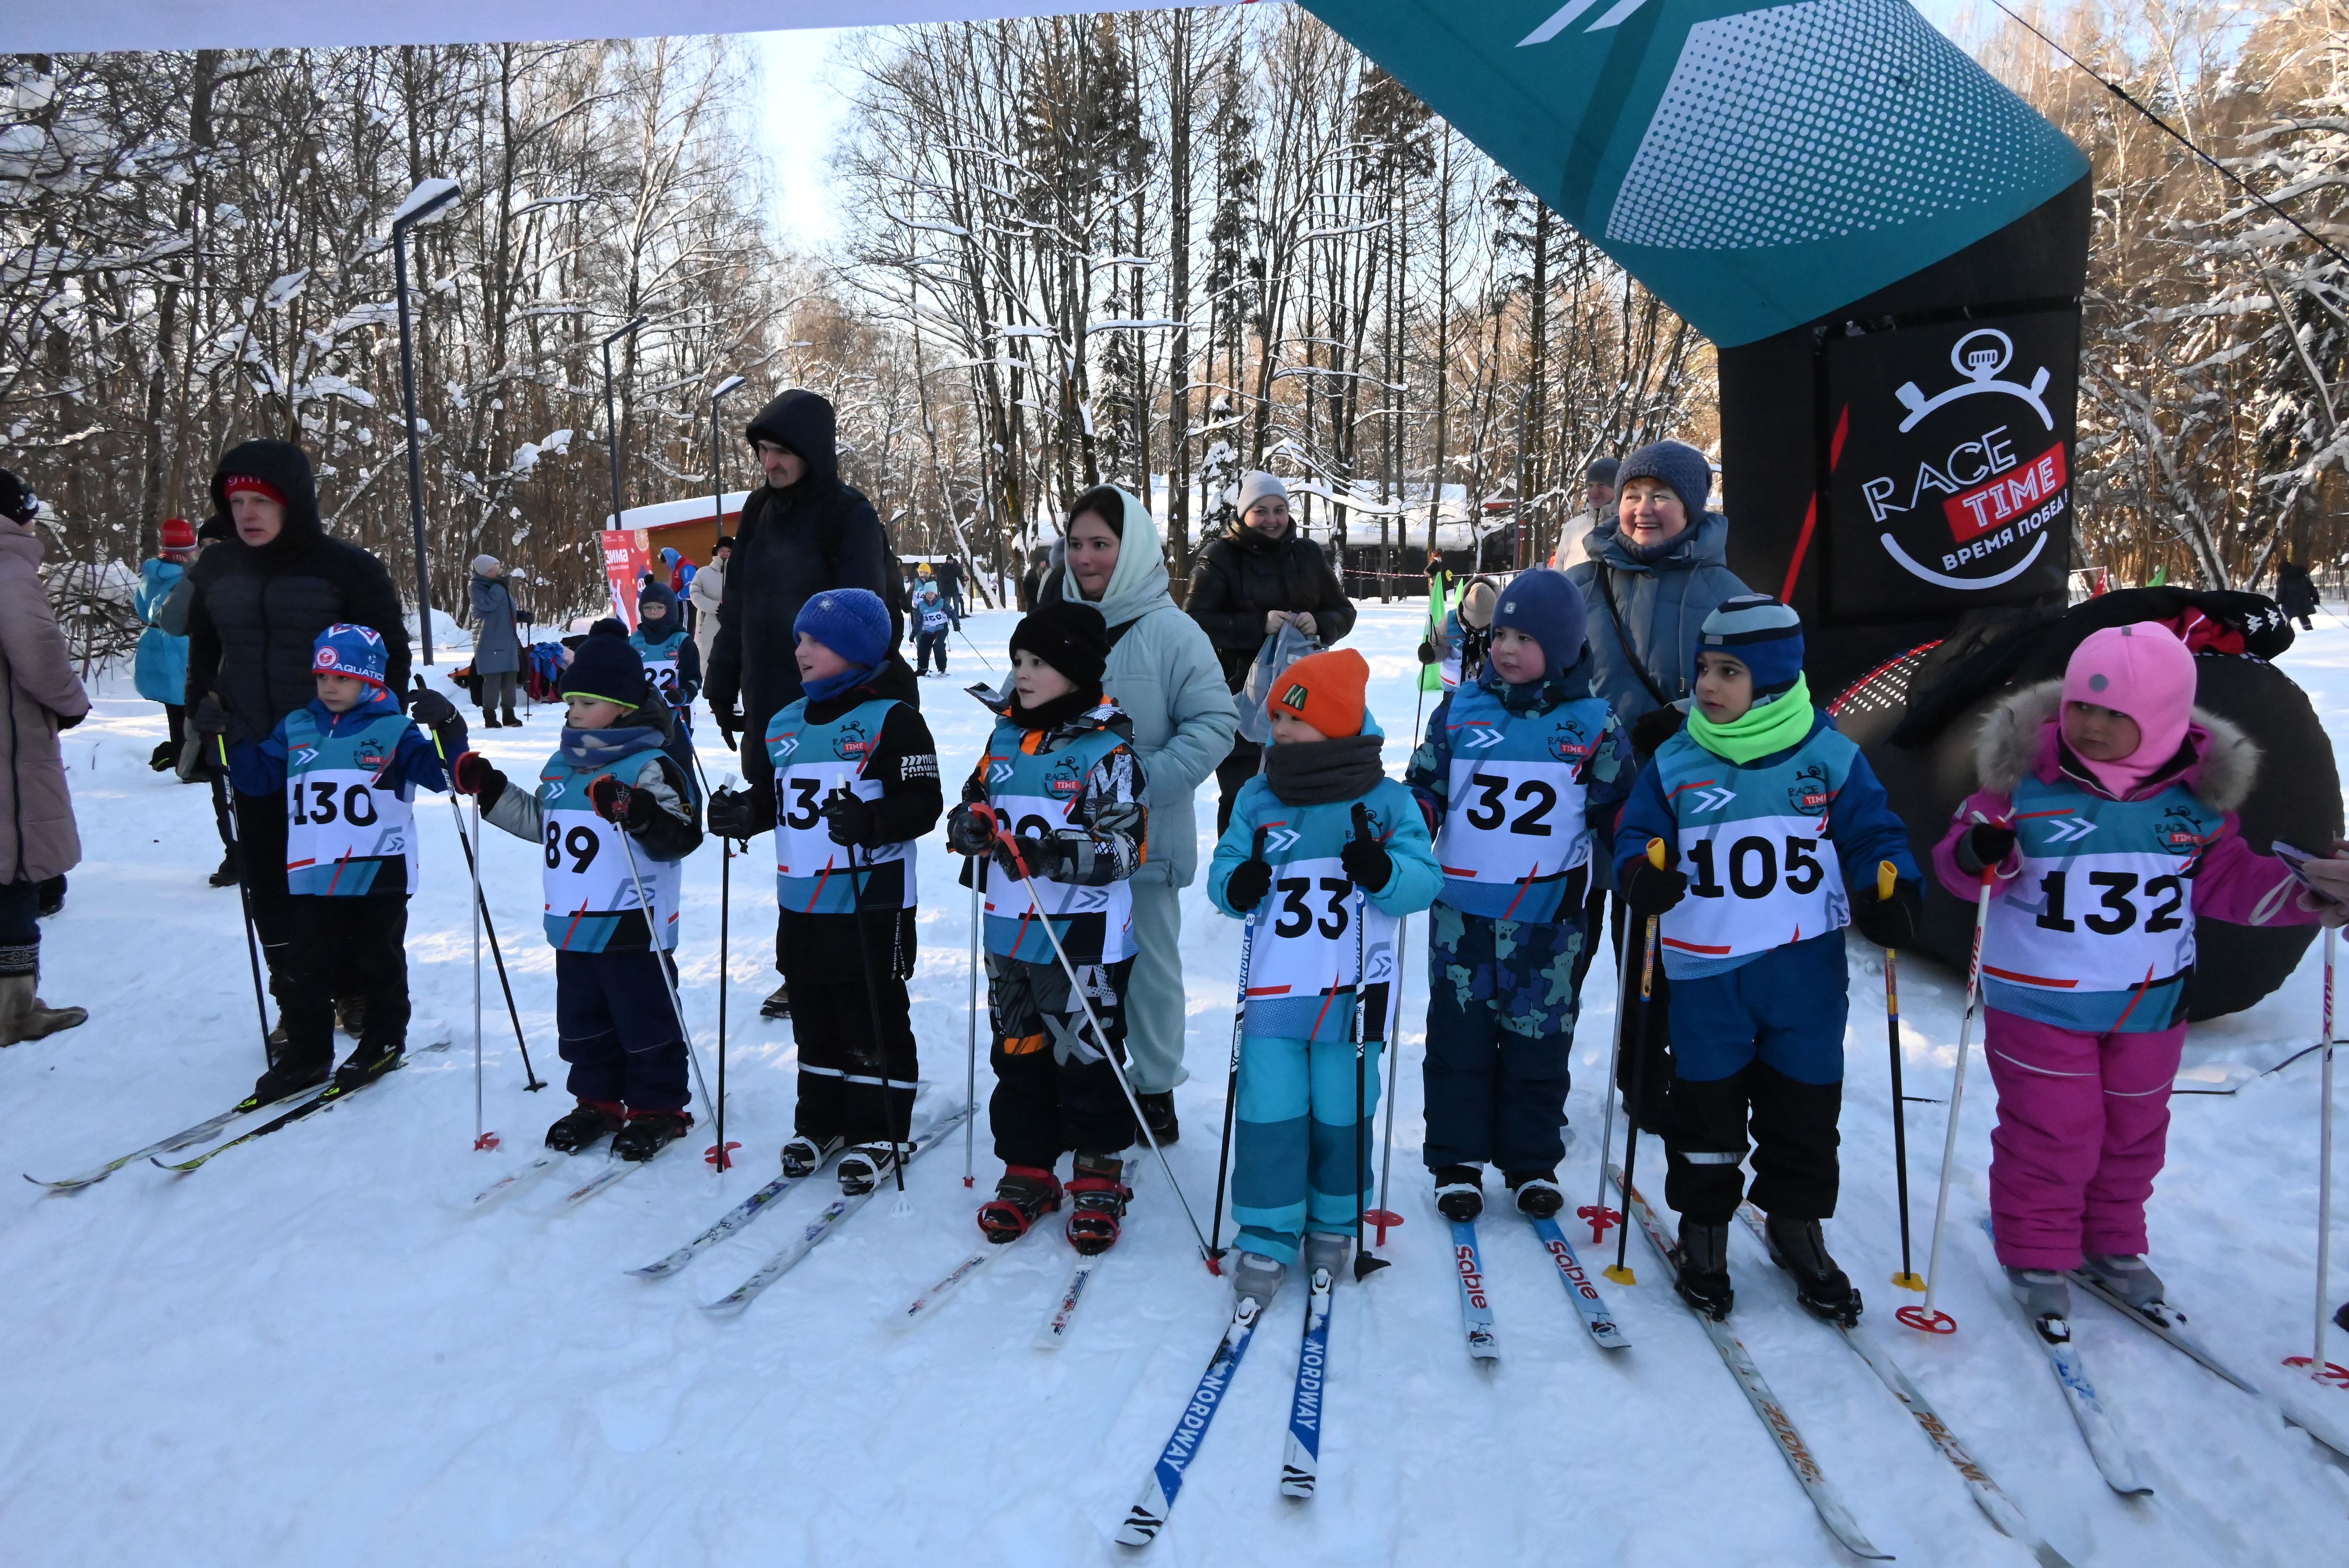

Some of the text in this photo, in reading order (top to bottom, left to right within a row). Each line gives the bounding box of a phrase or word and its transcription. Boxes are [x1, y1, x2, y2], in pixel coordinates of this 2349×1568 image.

[1862, 425, 2016, 522] RACE
[1962, 456, 2057, 527] TIME
[1942, 488, 2068, 571] ВРЕМЯ ПОБЕД!
[333, 663, 385, 682] AQUATICS
[833, 735, 855, 746] RACE
[1547, 736, 1574, 745] RACE
[1562, 745, 1582, 753] TIME
[294, 782, 378, 827] 130
[776, 778, 850, 830] 13
[1045, 773, 1069, 781] RACE
[1467, 773, 1556, 836] 32
[1788, 785, 1819, 797] RACE
[546, 821, 599, 874] 89
[1687, 836, 1824, 899] 105
[1275, 877, 1353, 939] 33
[2036, 871, 2183, 935] 132
[1238, 935, 1251, 995] NORDWAY
[1967, 925, 1982, 999] SWIX
[1238, 1022, 1243, 1033] JR
[1356, 1006, 1363, 1016] JR
[1296, 1340, 1324, 1431] NORDWAY
[1163, 1374, 1225, 1472] NORDWAY
